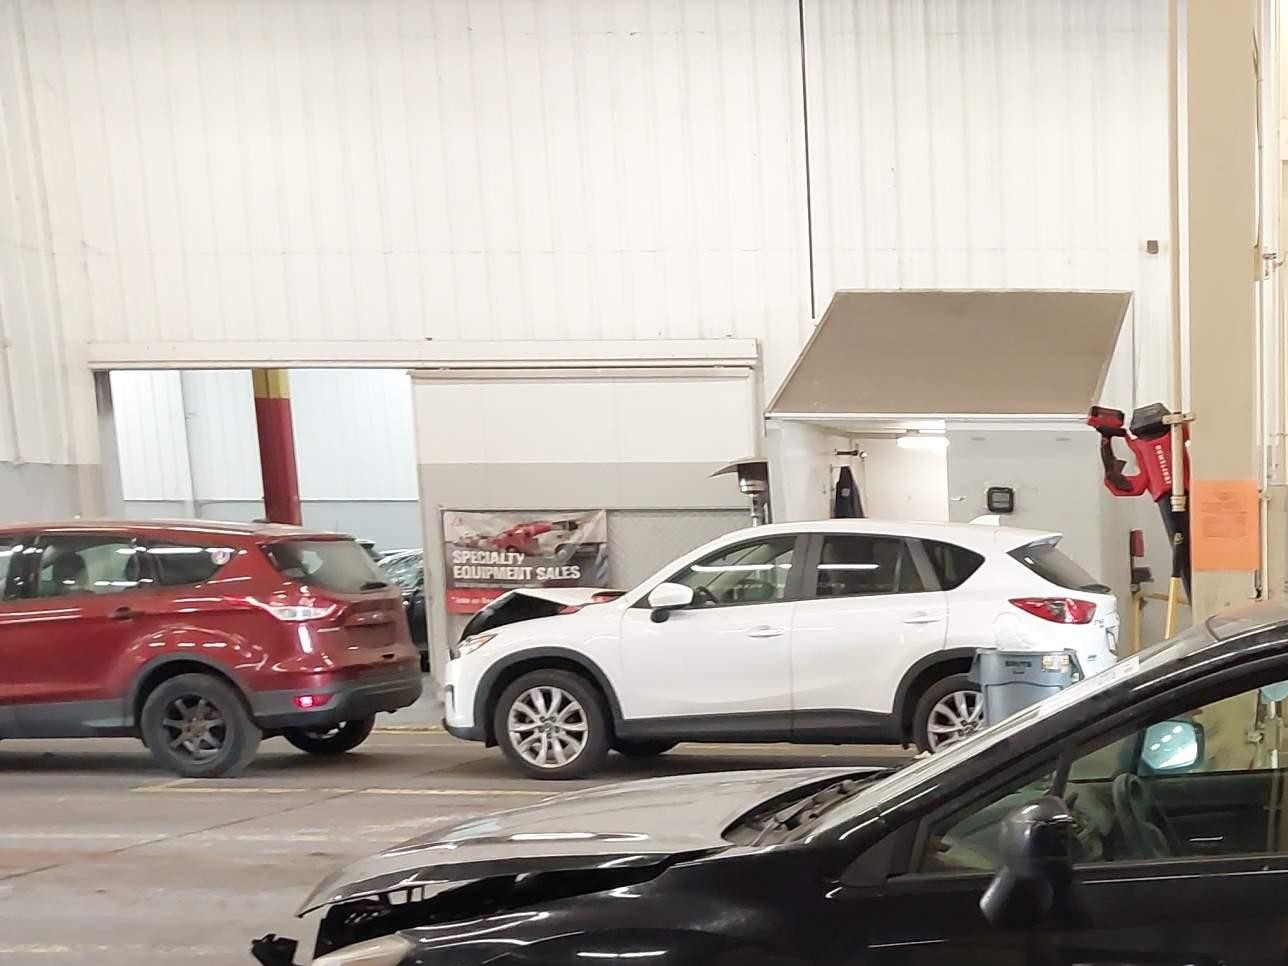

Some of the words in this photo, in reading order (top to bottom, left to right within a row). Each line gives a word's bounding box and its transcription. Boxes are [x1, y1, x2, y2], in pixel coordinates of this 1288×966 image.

[452, 550, 525, 565] SPECIALTY
[453, 565, 533, 580] EQUIPMENT
[535, 565, 582, 580] SALES
